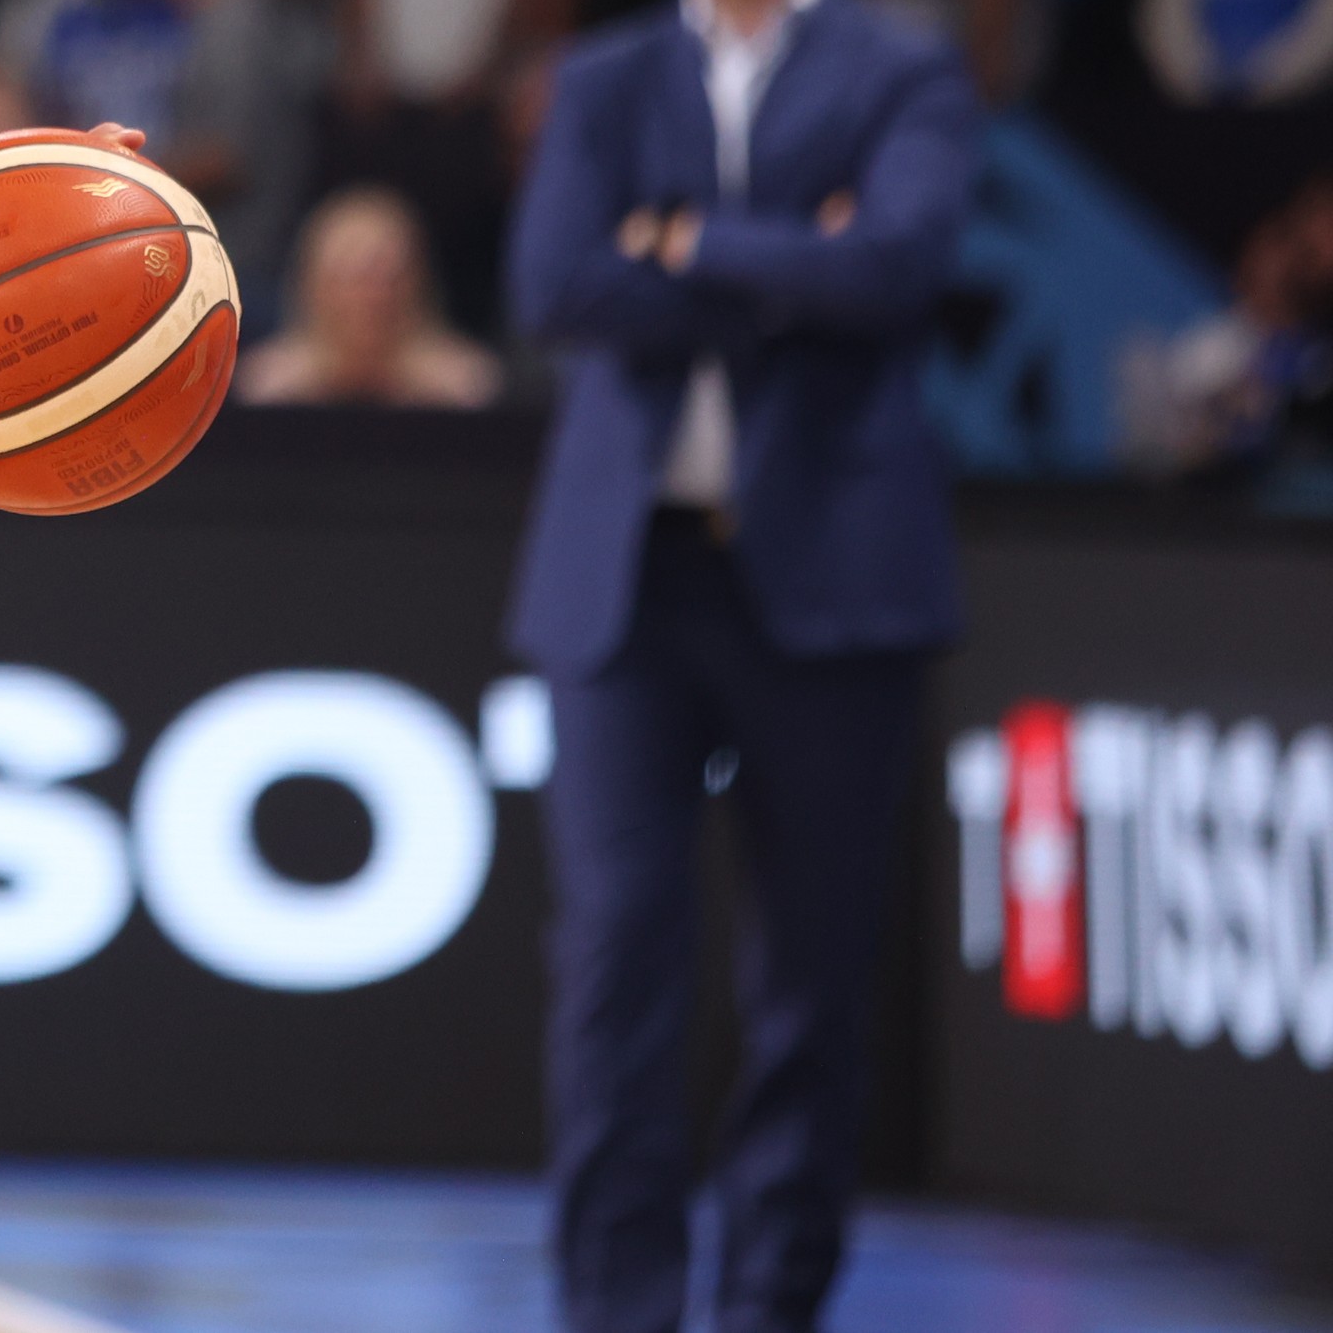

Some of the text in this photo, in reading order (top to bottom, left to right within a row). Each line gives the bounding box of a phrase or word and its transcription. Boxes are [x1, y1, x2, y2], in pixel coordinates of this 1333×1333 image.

[22, 325, 72, 358] OFFICIAL
[56, 438, 131, 481] APPROVED
[66, 449, 146, 498] FIBA
